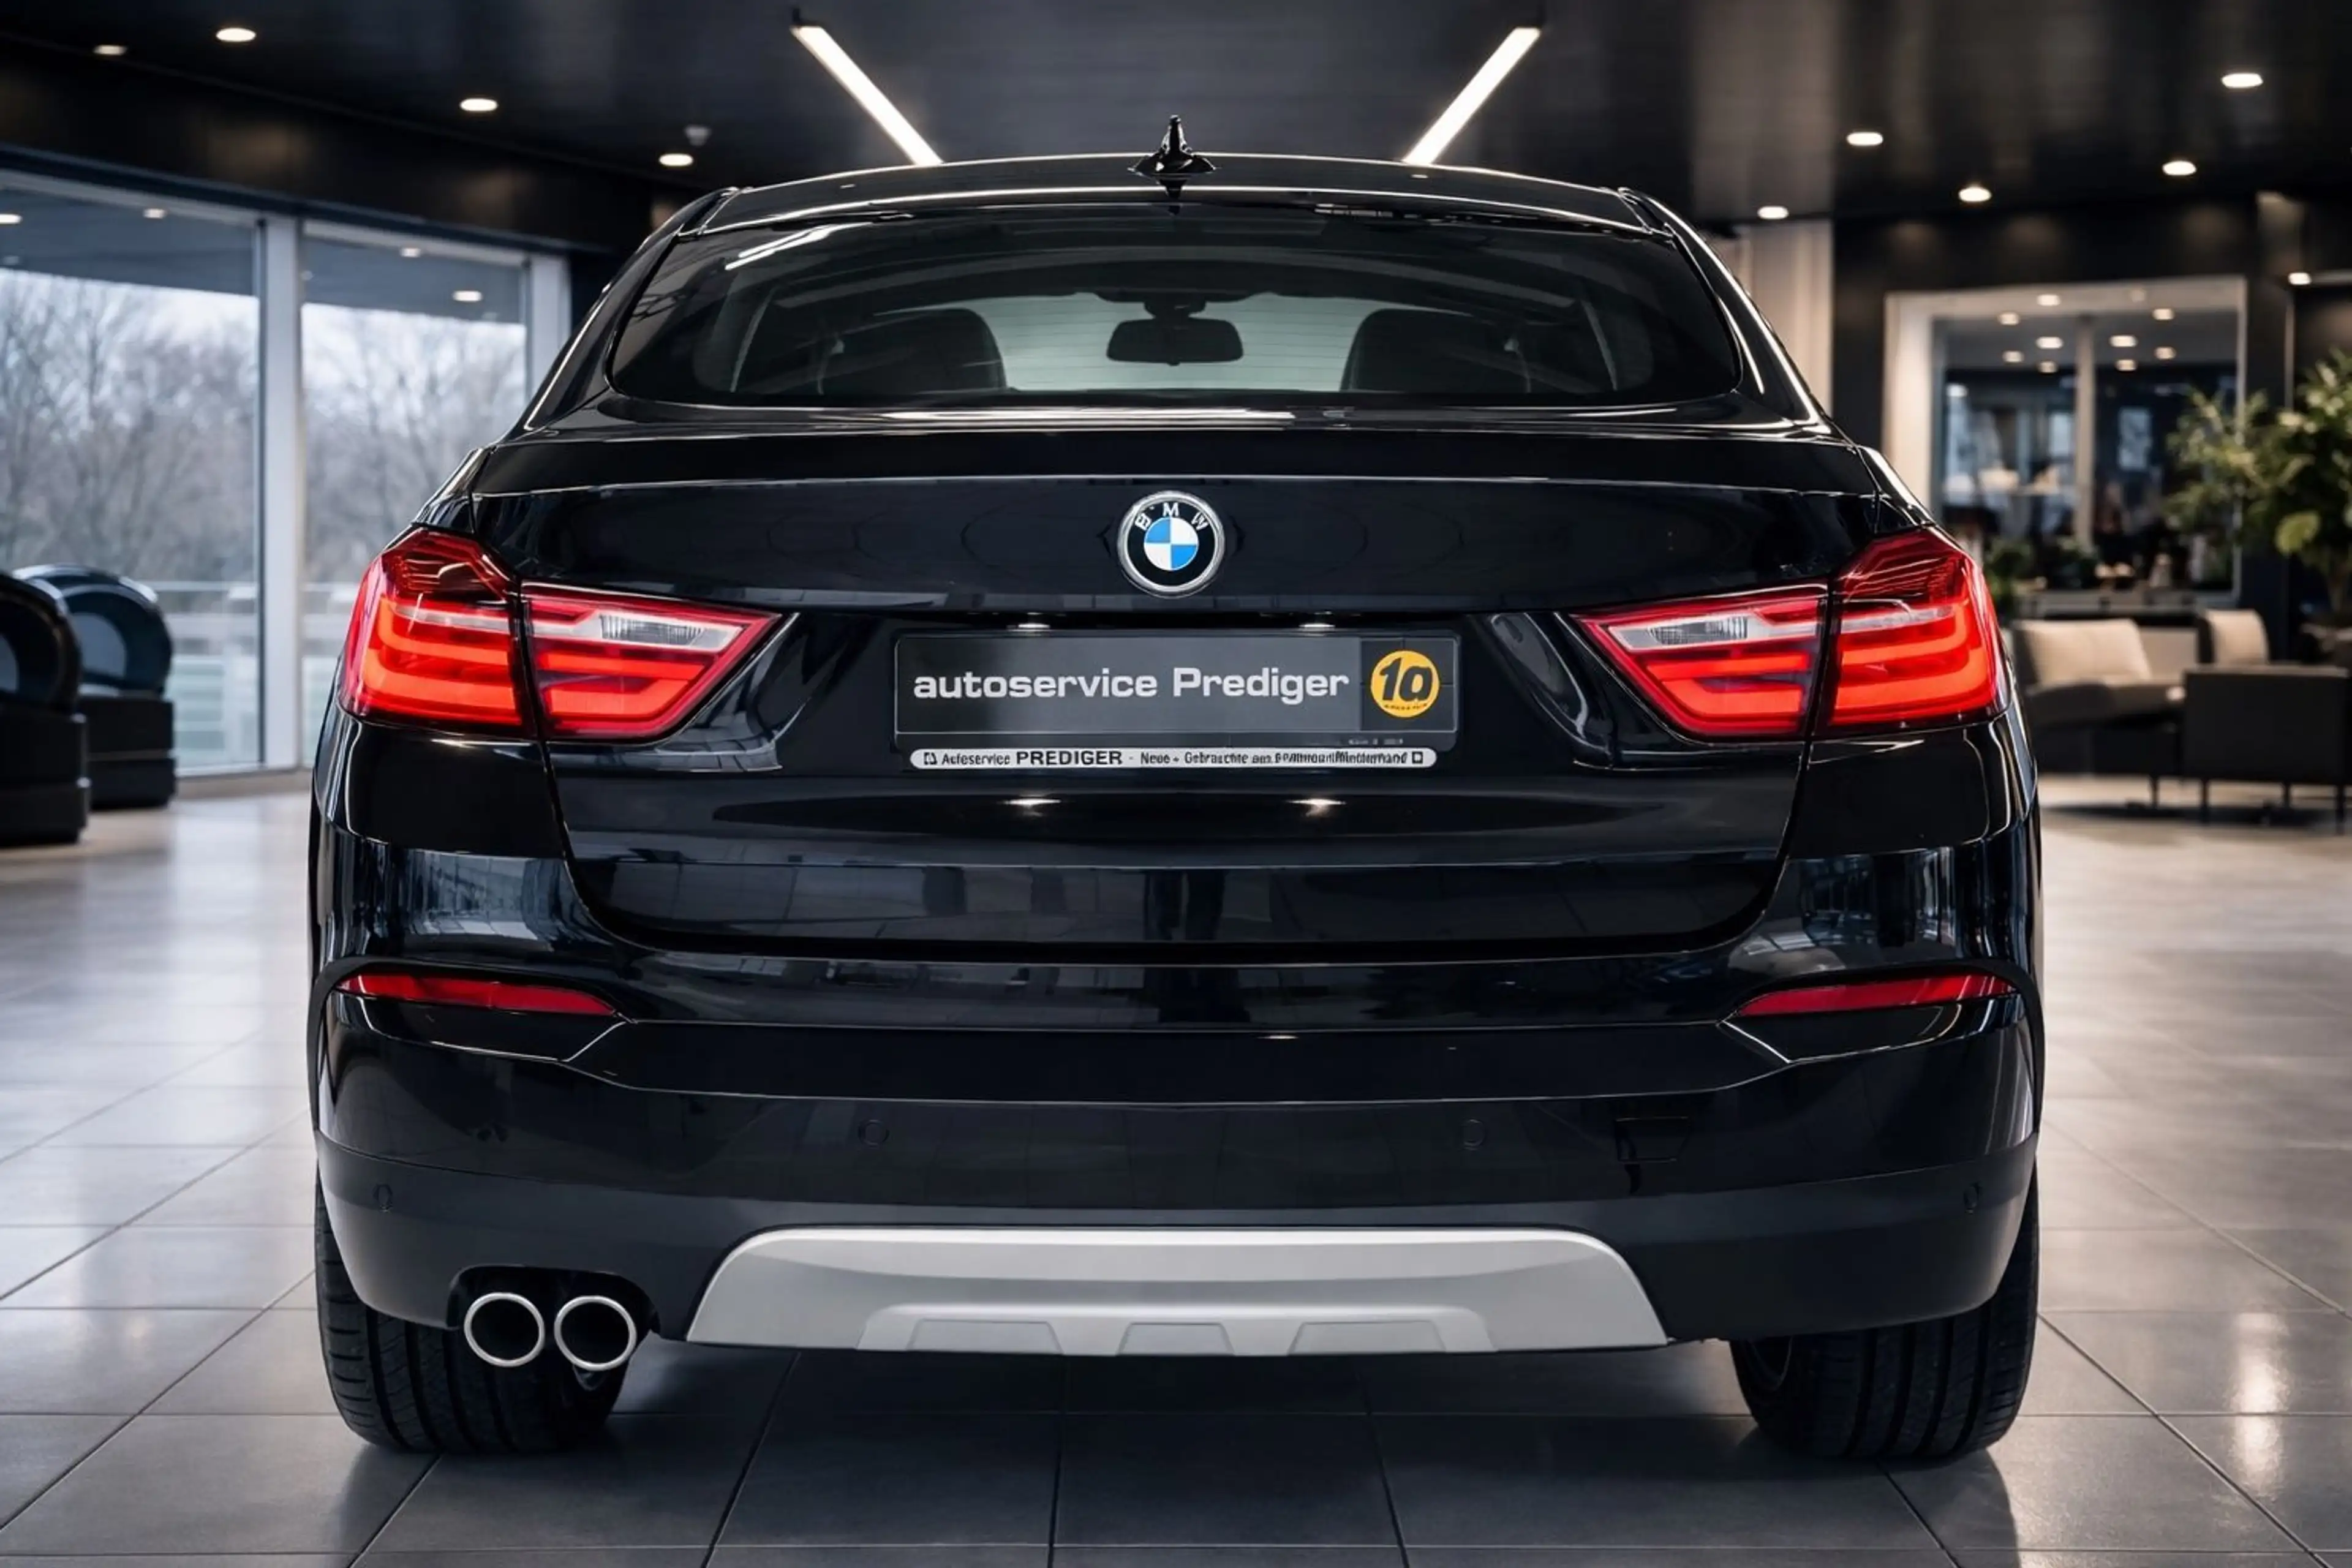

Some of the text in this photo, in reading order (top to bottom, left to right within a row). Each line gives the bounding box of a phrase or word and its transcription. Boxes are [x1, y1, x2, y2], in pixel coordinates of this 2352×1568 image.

[1134, 502, 1208, 531] BMW
[913, 666, 1350, 705] autoservice Prediger
[1016, 750, 1123, 766] PREDIGER
